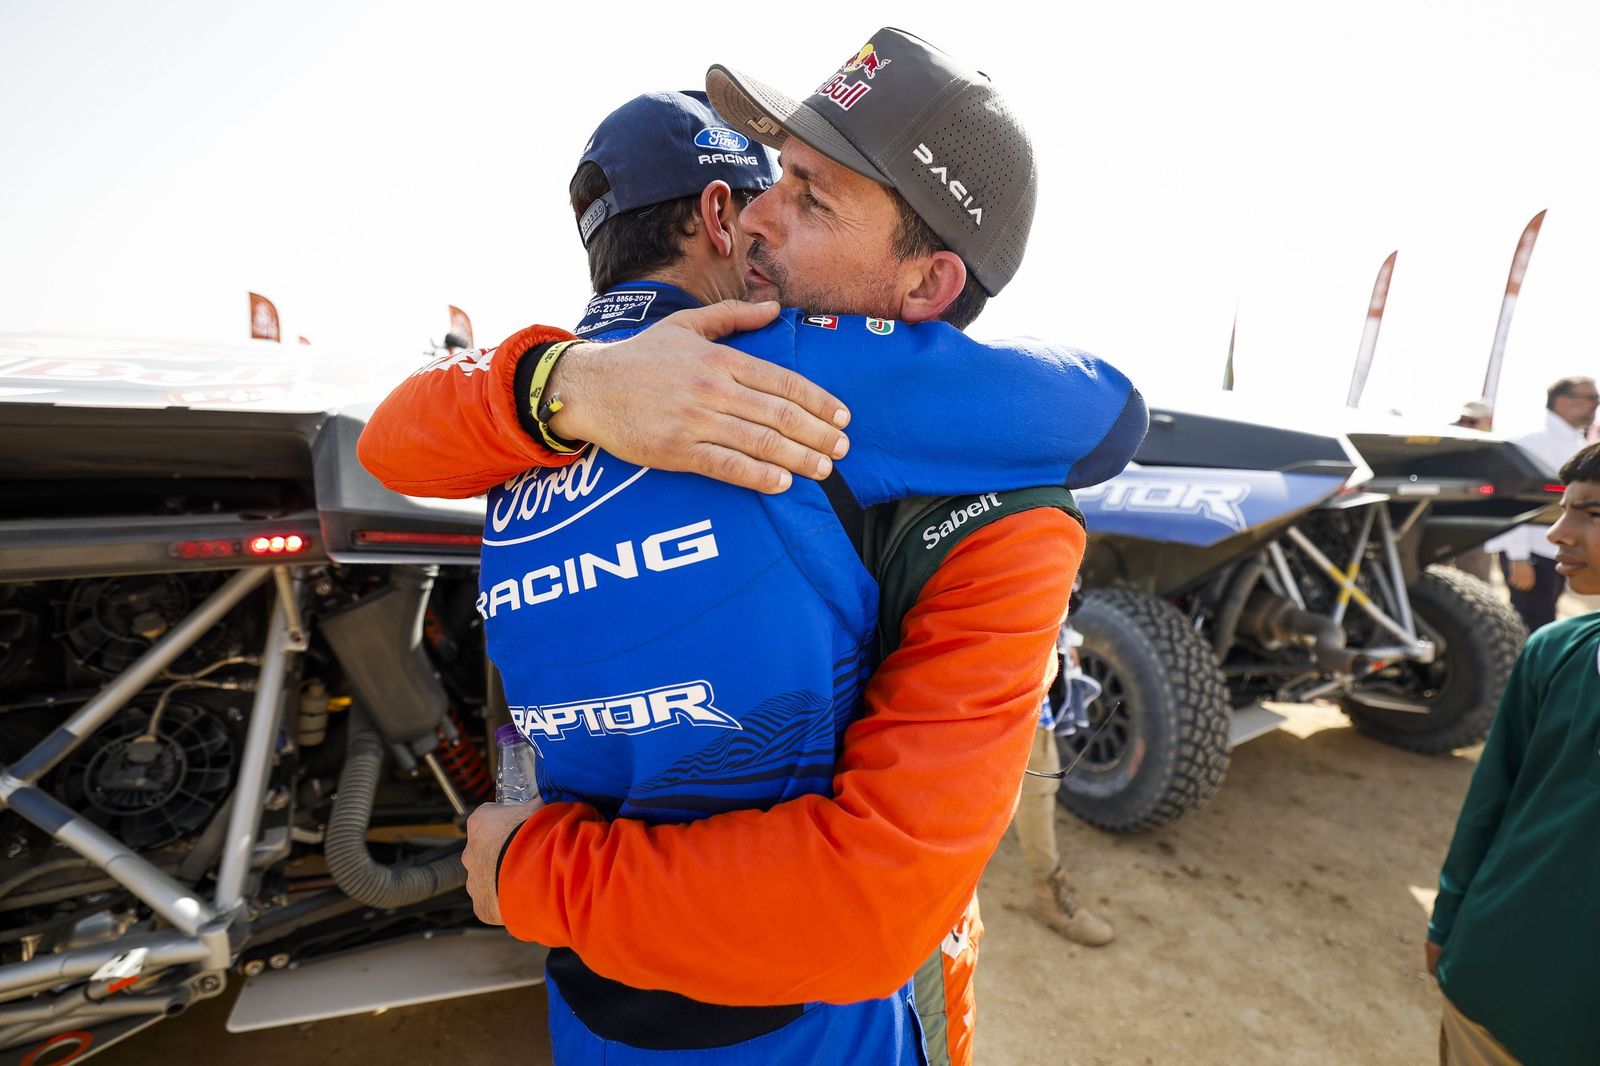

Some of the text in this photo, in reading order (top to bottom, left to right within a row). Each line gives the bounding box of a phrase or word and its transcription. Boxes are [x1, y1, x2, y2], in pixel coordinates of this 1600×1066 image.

[818, 74, 871, 111] Bull
[698, 153, 758, 165] RACING
[708, 129, 741, 148] Ford
[912, 142, 982, 226] DACIA
[492, 447, 604, 533] Ford
[922, 492, 1003, 550] Sabelt
[476, 519, 719, 620] RACING
[508, 680, 743, 748] RAPTOR
